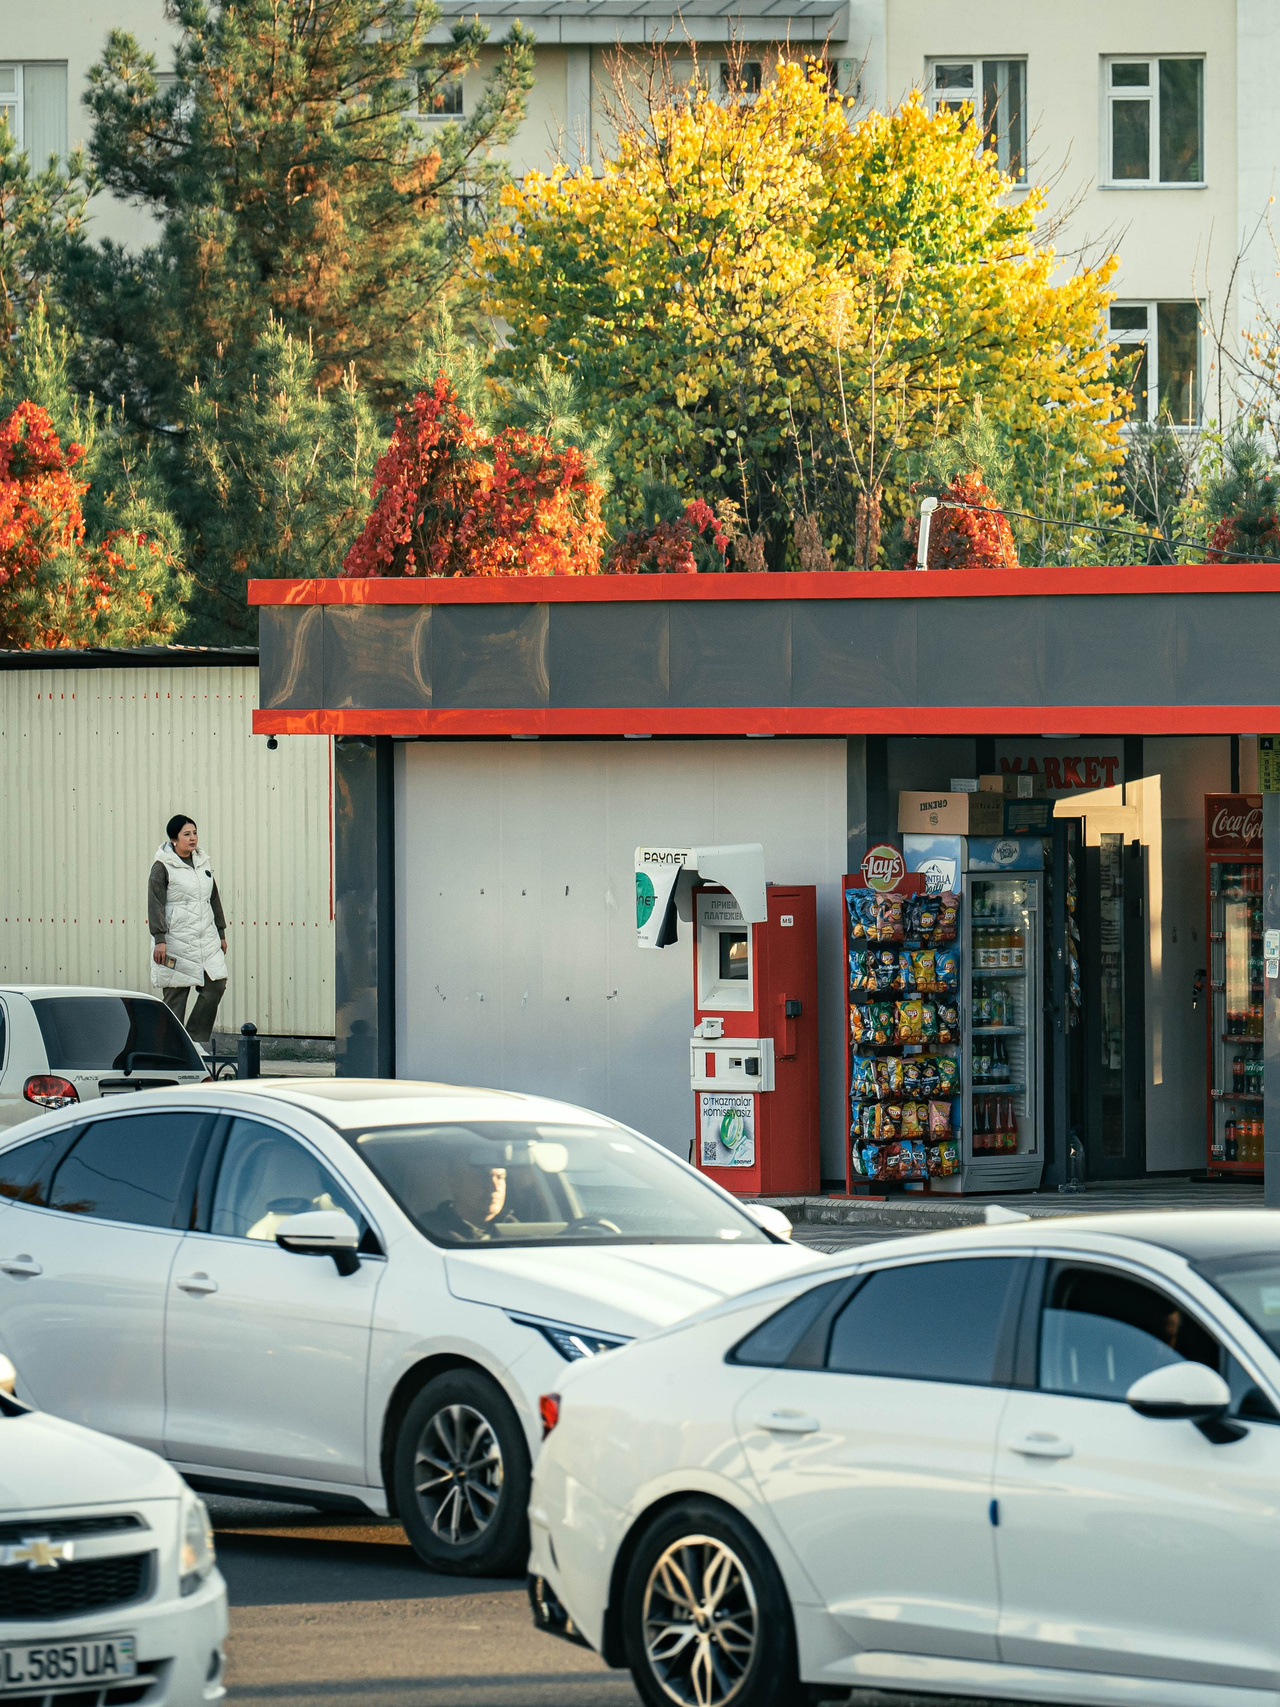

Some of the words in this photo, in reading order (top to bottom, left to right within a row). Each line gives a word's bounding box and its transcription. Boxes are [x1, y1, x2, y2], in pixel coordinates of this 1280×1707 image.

[1211, 808, 1263, 840] Coca-Col
[643, 851, 688, 865] PAYNET
[867, 855, 901, 884] Lay's
[711, 900, 738, 909] ПРИЕМ
